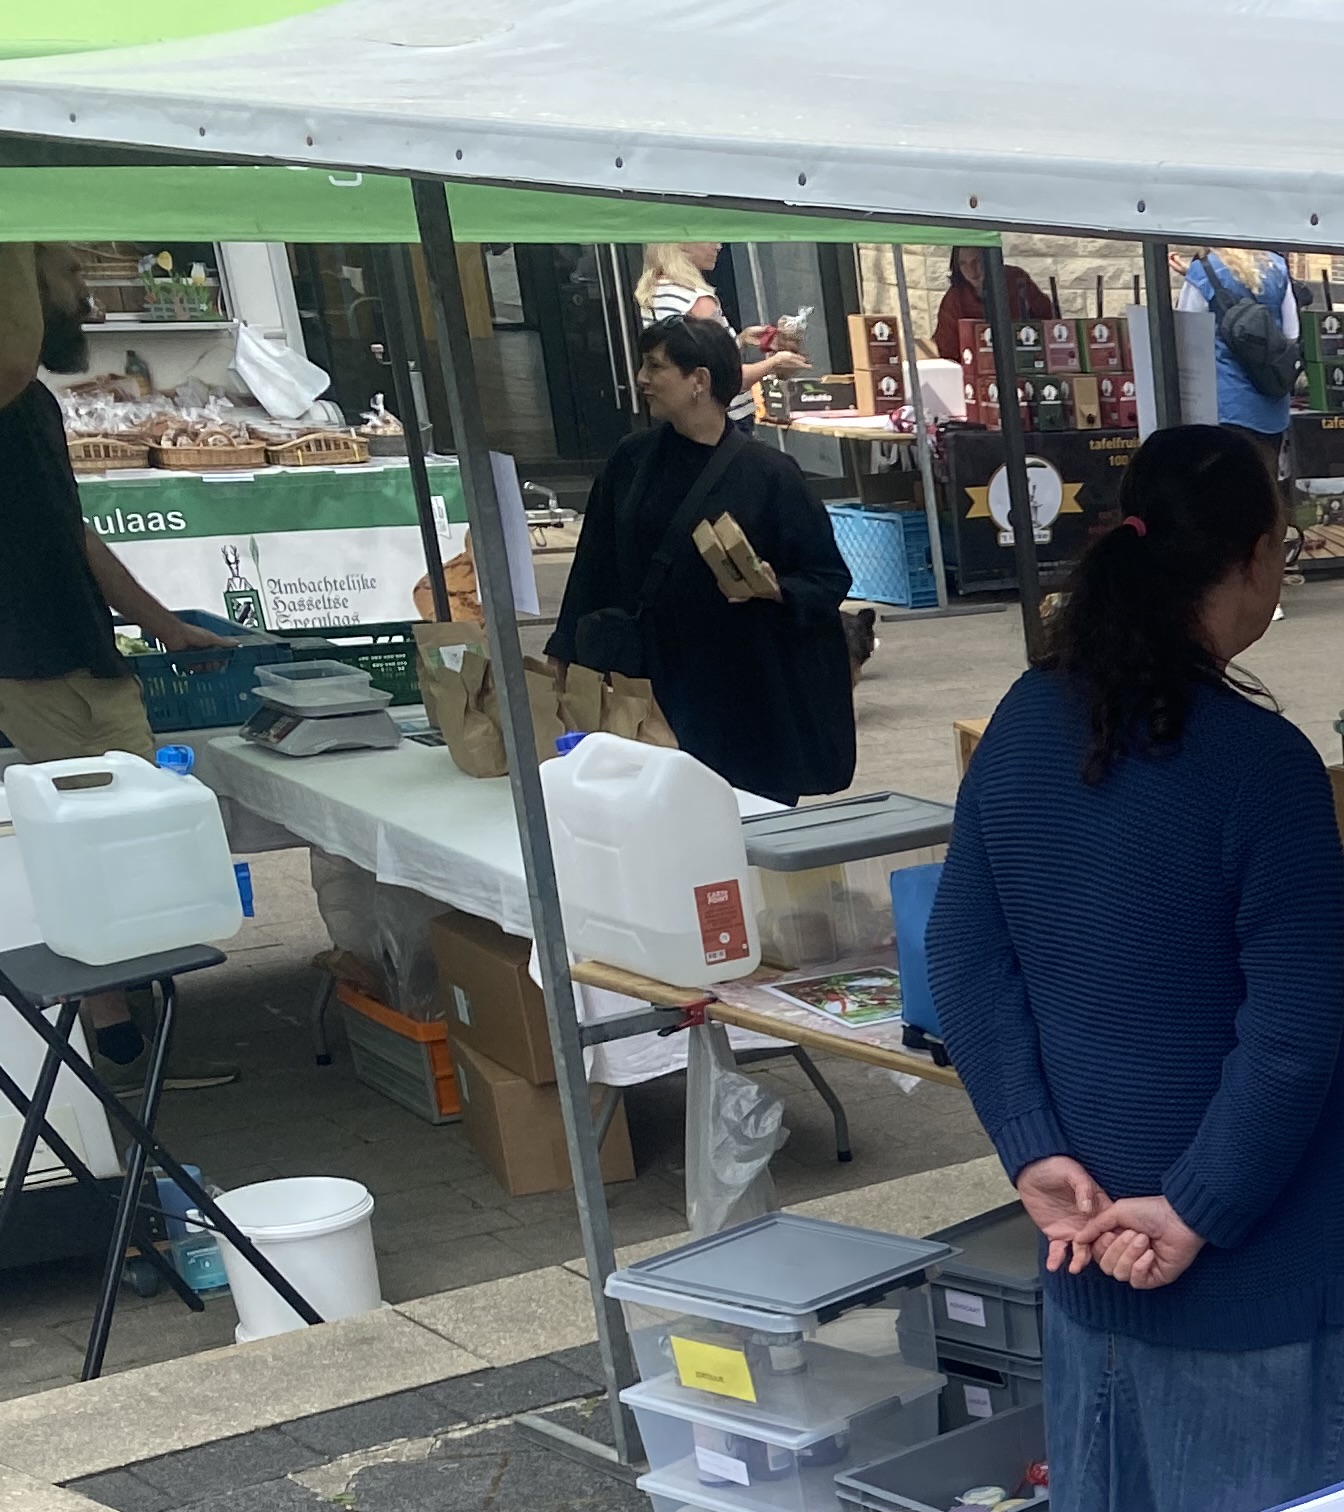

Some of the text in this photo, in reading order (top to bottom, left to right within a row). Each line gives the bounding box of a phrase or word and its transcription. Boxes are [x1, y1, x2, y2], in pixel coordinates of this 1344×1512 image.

[82, 508, 187, 535] ulaas
[266, 573, 377, 595] Ambachtelijke
[272, 594, 349, 613] Hasseltse
